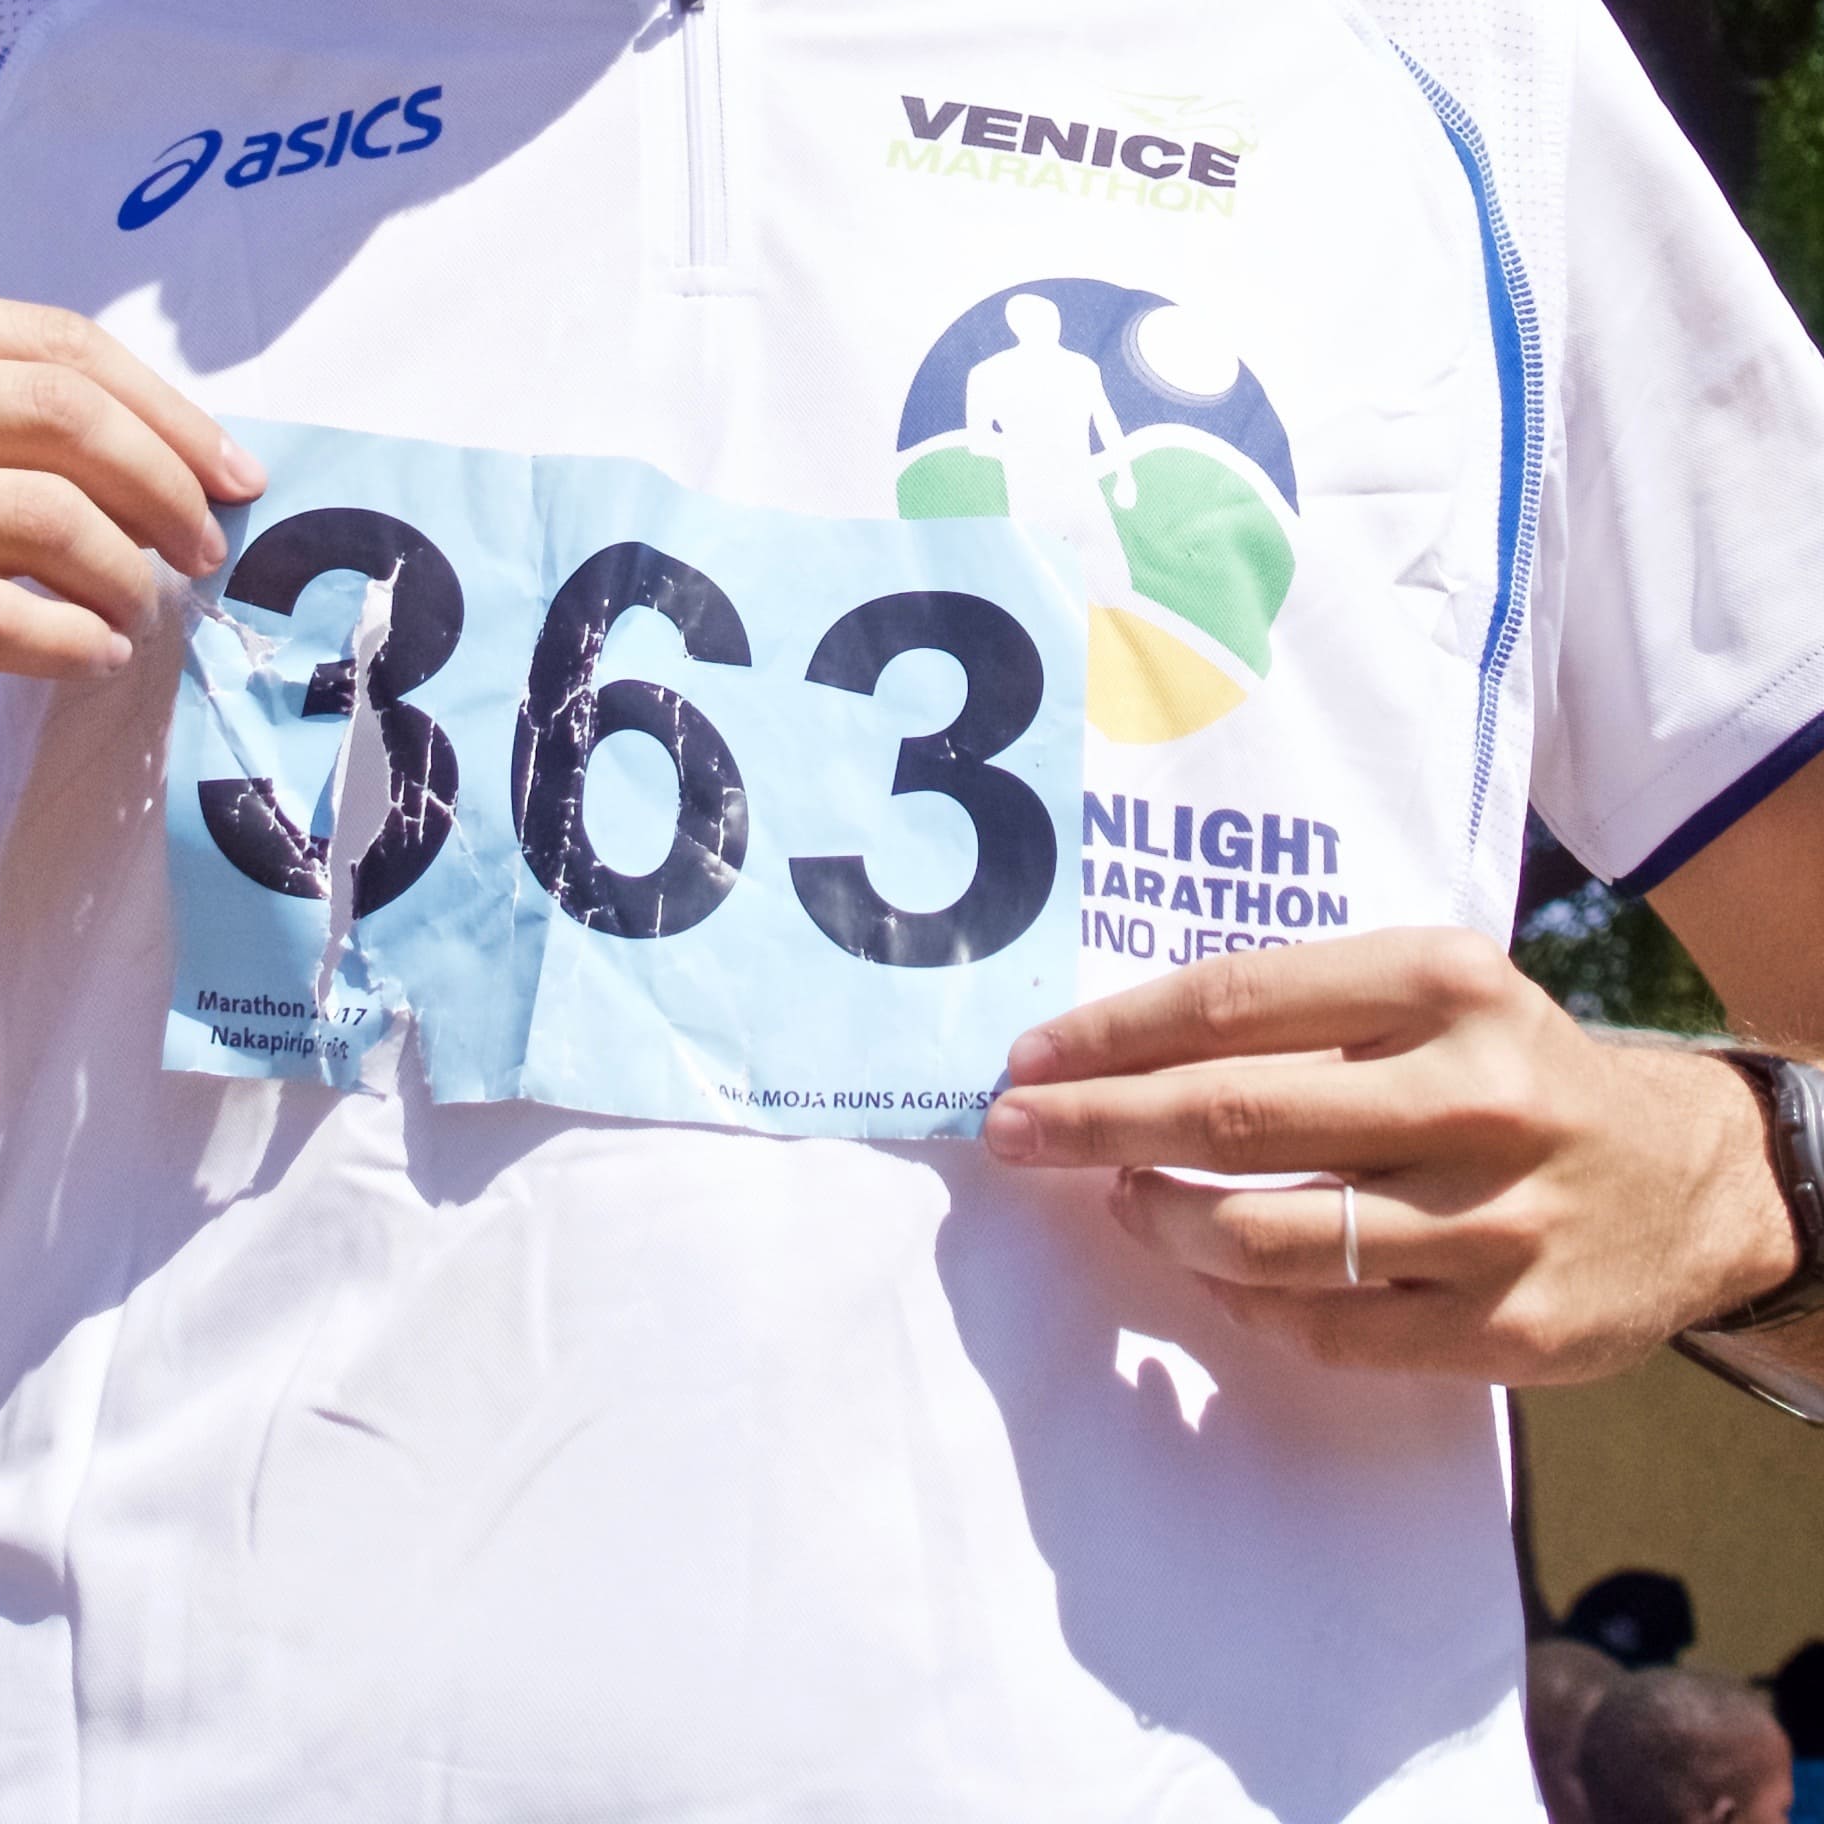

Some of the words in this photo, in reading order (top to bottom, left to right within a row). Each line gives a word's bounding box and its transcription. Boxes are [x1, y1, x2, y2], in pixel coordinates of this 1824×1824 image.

[884, 139, 1236, 218] MARATHON
[901, 95, 1240, 188] VENICE
[196, 506, 1058, 969] 363
[197, 990, 305, 1018] Marathon
[702, 1083, 826, 1109] ARAMOJA
[832, 1090, 895, 1109] RUNS
